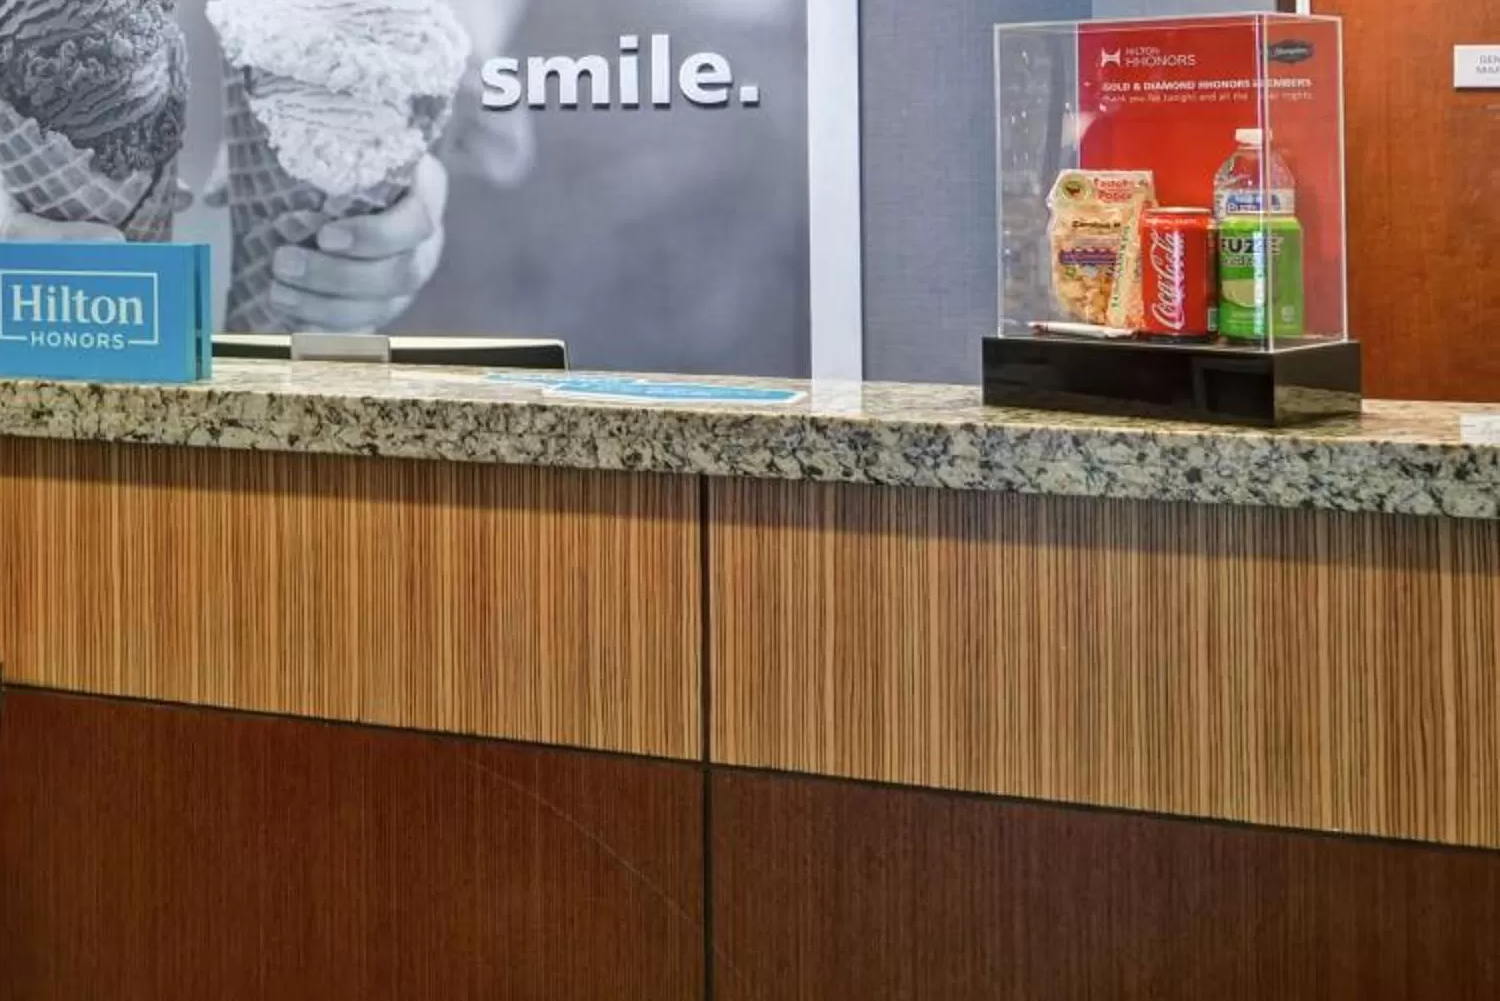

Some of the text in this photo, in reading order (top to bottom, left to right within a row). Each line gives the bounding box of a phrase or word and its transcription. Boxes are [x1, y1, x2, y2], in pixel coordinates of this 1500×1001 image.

[481, 34, 760, 108] smile.
[1124, 54, 1197, 68] HHONORS
[1143, 81, 1196, 91] DIAMOND
[8, 283, 145, 326] Hilton
[30, 330, 125, 350] HONORS
